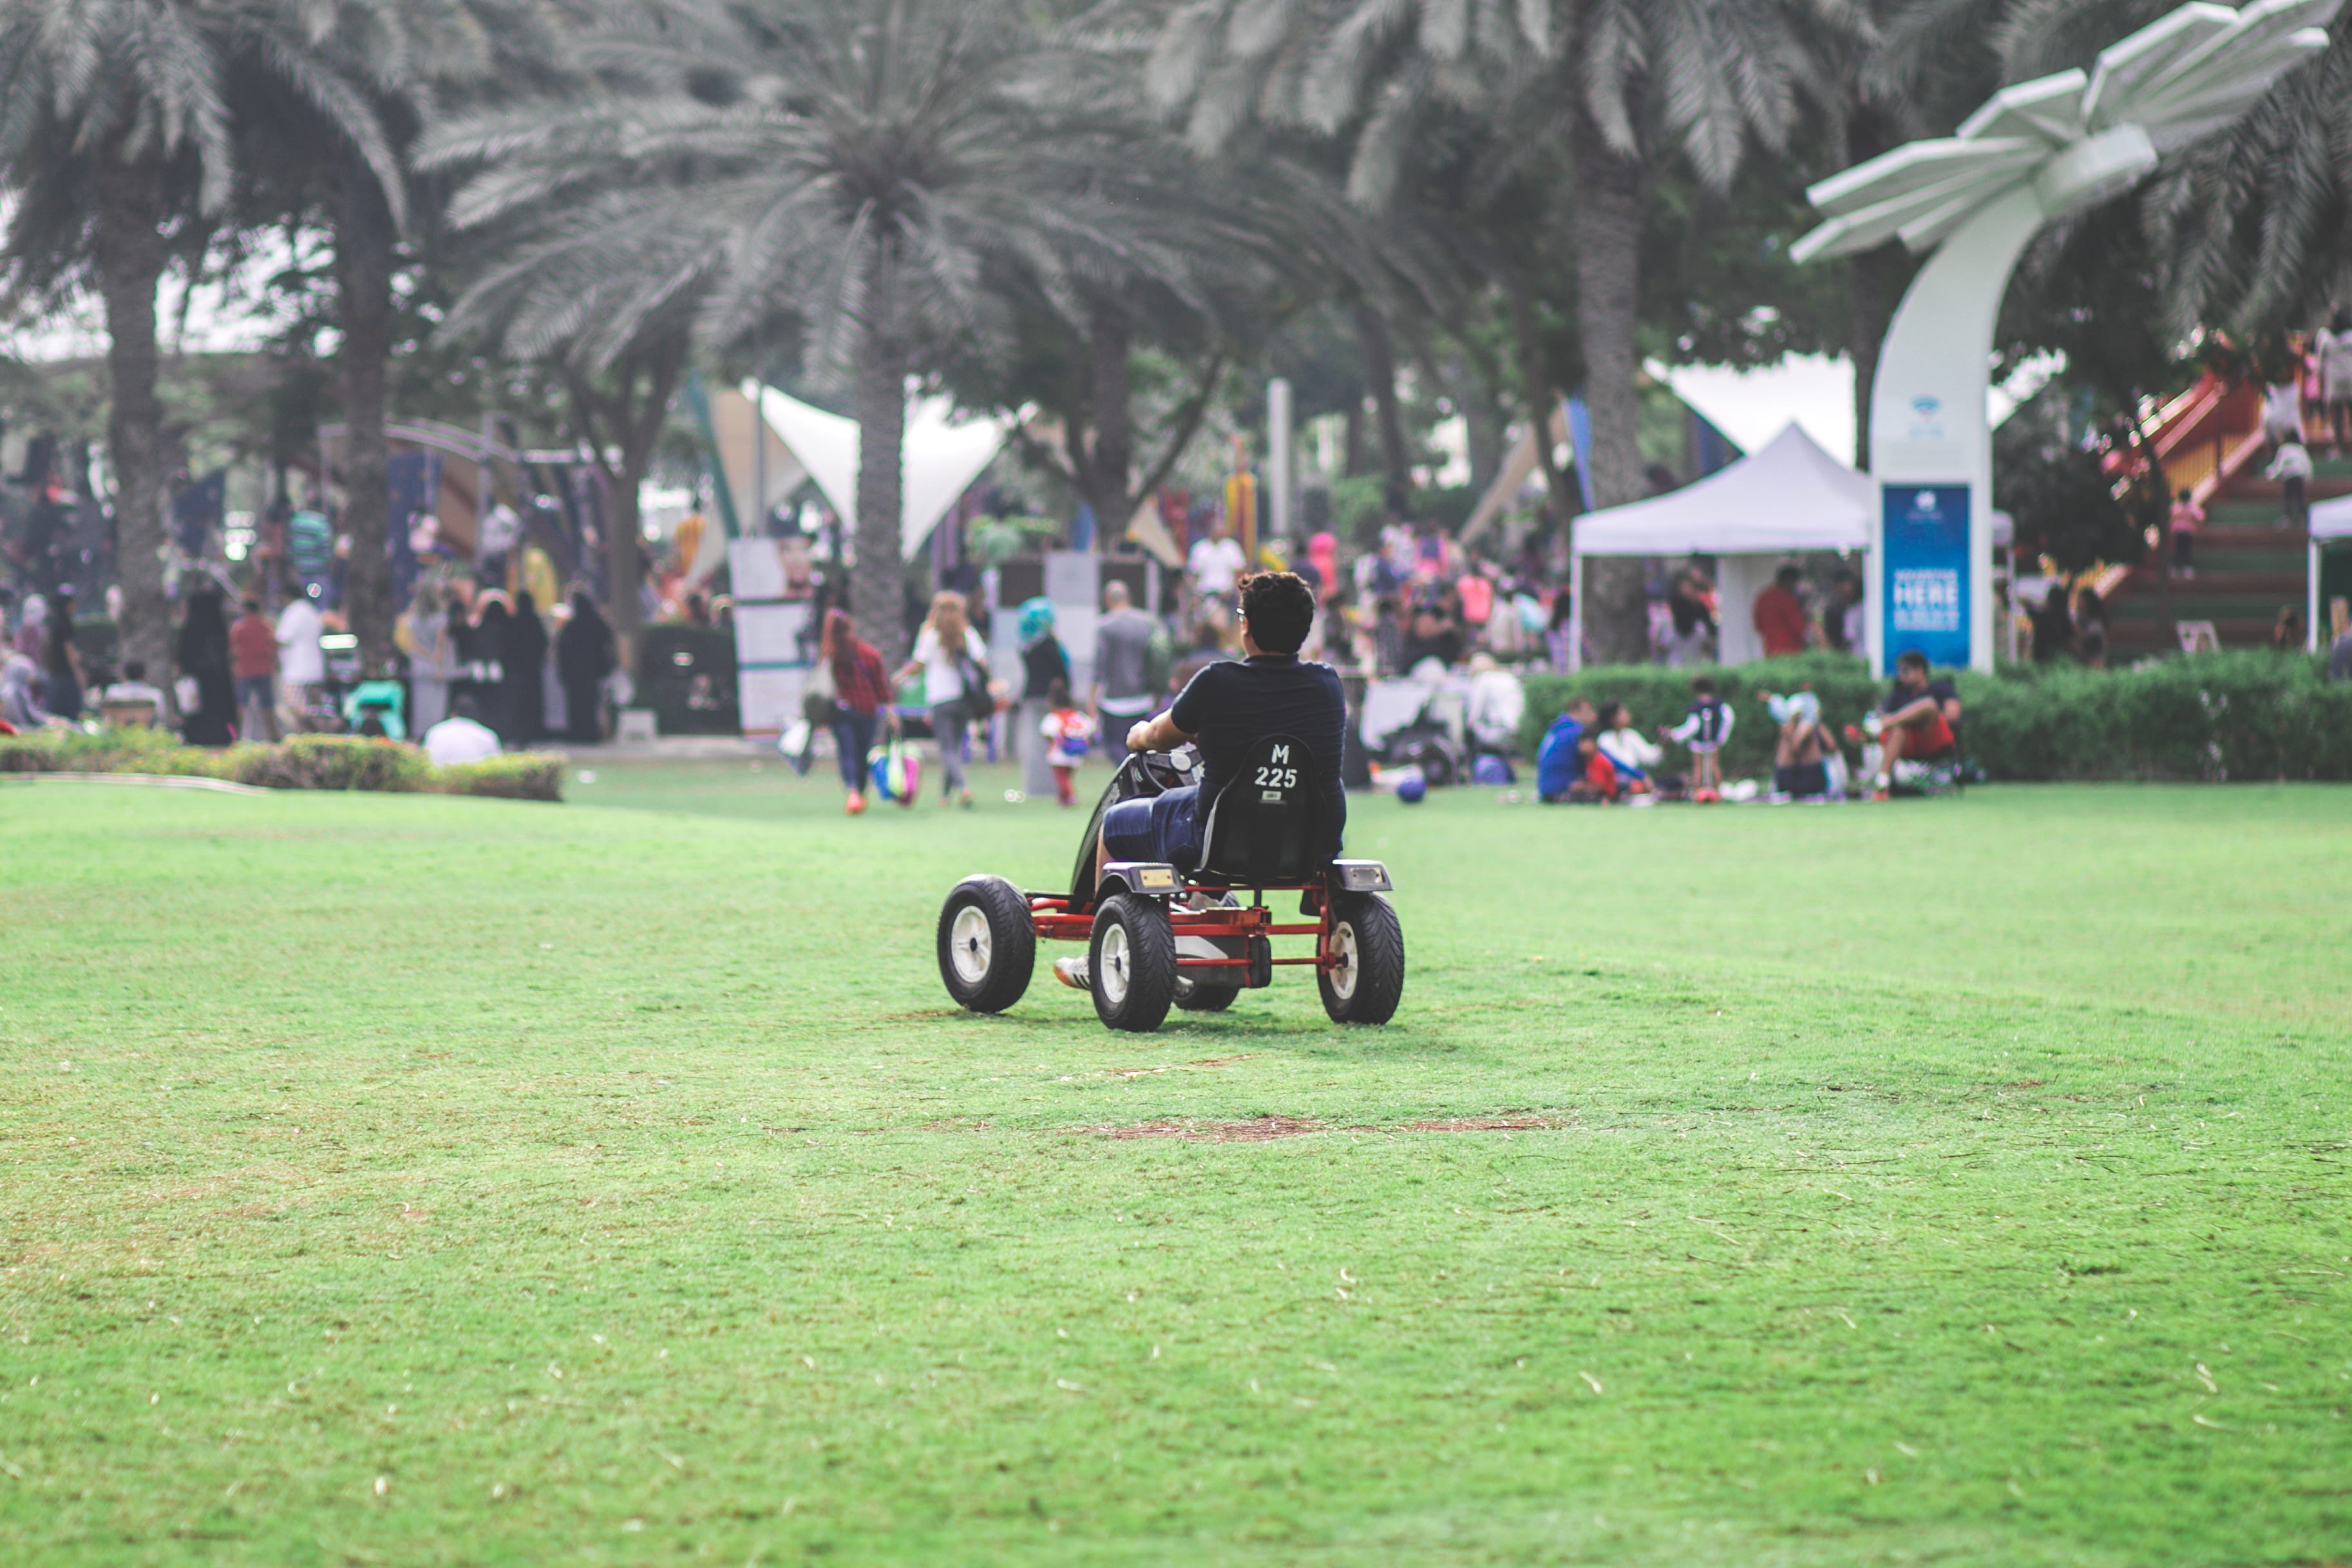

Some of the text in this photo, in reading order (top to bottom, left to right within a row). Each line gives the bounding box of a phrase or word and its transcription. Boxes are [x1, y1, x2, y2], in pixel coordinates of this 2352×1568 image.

[1894, 581, 1958, 607] HERE
[1271, 744, 1289, 764] M
[1254, 766, 1298, 788] 225
